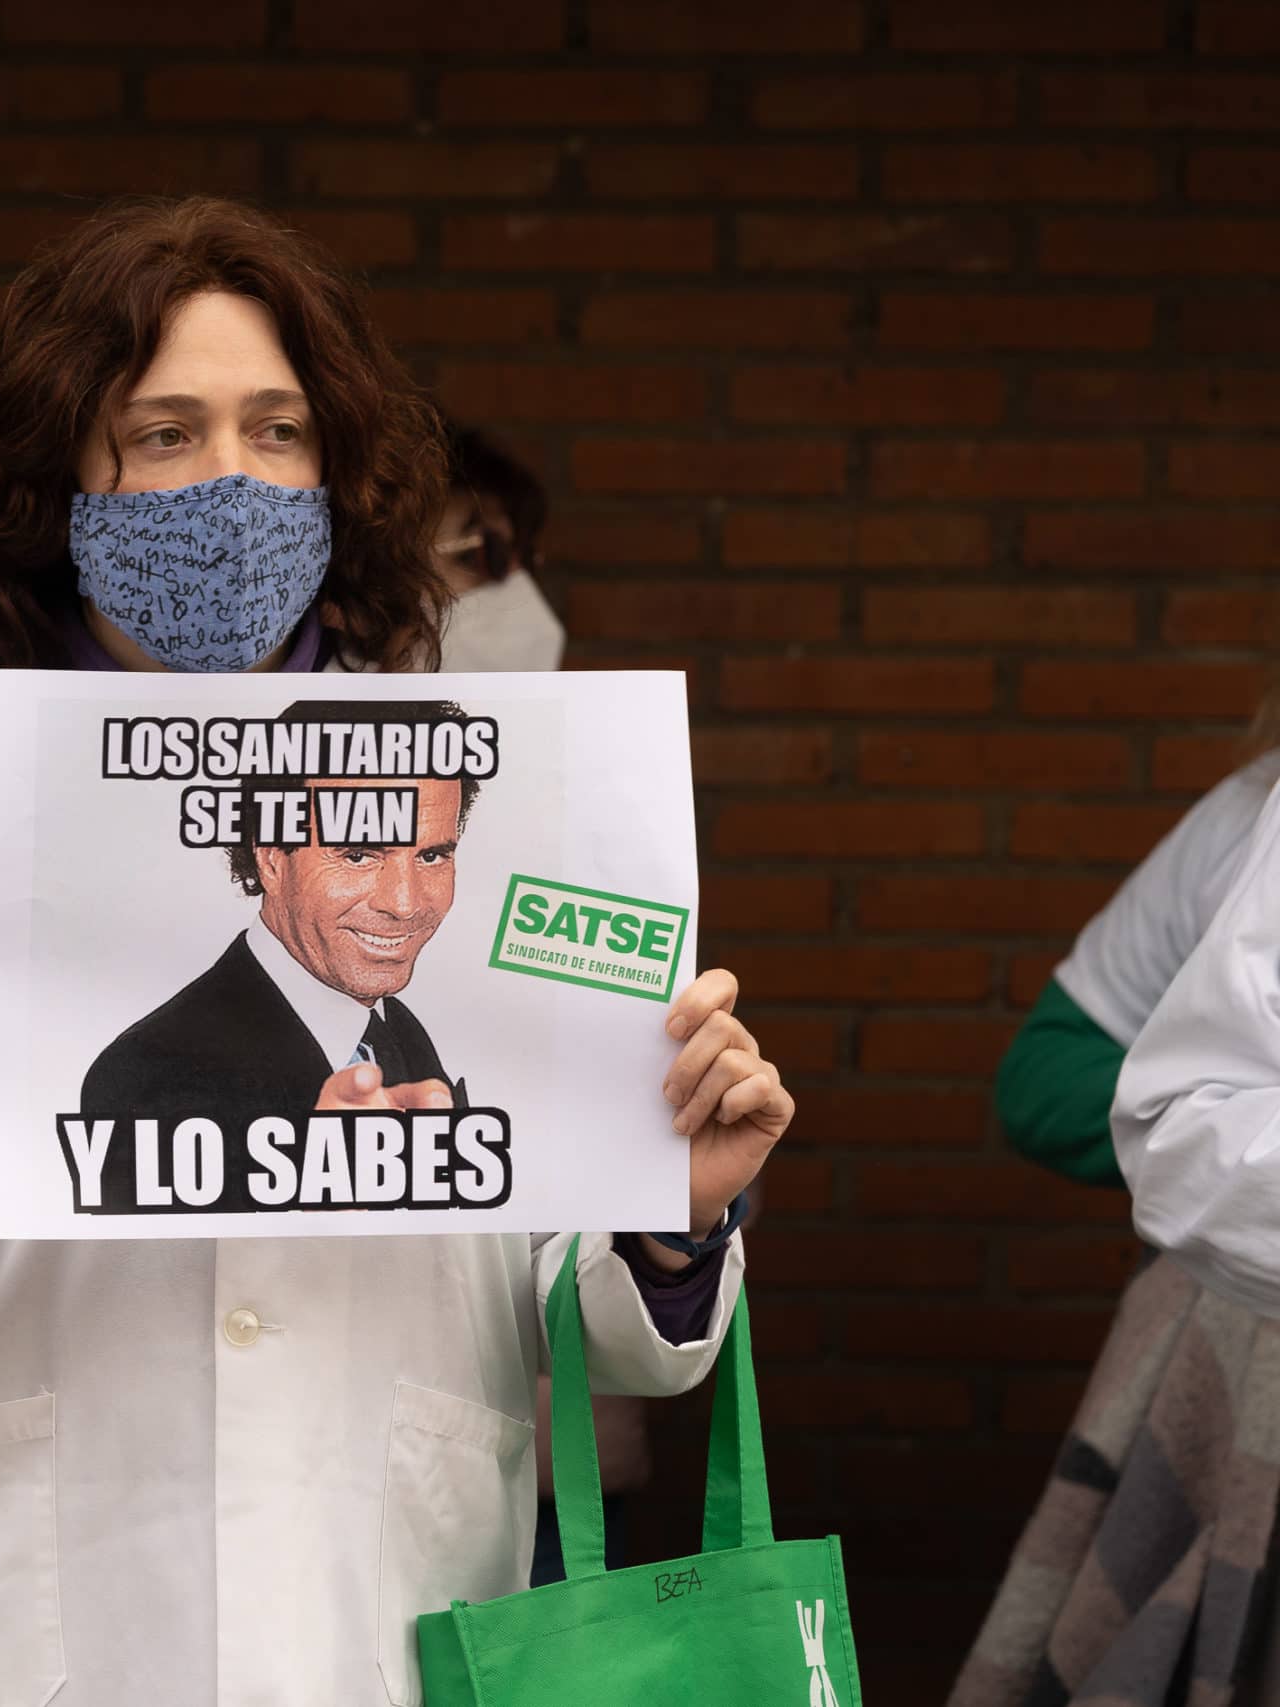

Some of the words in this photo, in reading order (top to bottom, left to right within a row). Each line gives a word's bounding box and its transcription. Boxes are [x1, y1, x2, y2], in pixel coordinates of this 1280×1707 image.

[105, 719, 196, 778] LOS
[206, 719, 497, 778] SANITARIOS
[183, 788, 243, 846] SE
[252, 788, 309, 846] TE
[317, 788, 416, 846] VAN
[513, 893, 675, 962] SATSE
[506, 943, 567, 967] SINDICATO
[571, 957, 585, 970] DE
[588, 961, 662, 987] ENFERMERÍA
[63, 1119, 115, 1207] Y
[134, 1117, 224, 1207] LO
[246, 1114, 505, 1206] SABES
[655, 1567, 702, 1604] BEA
